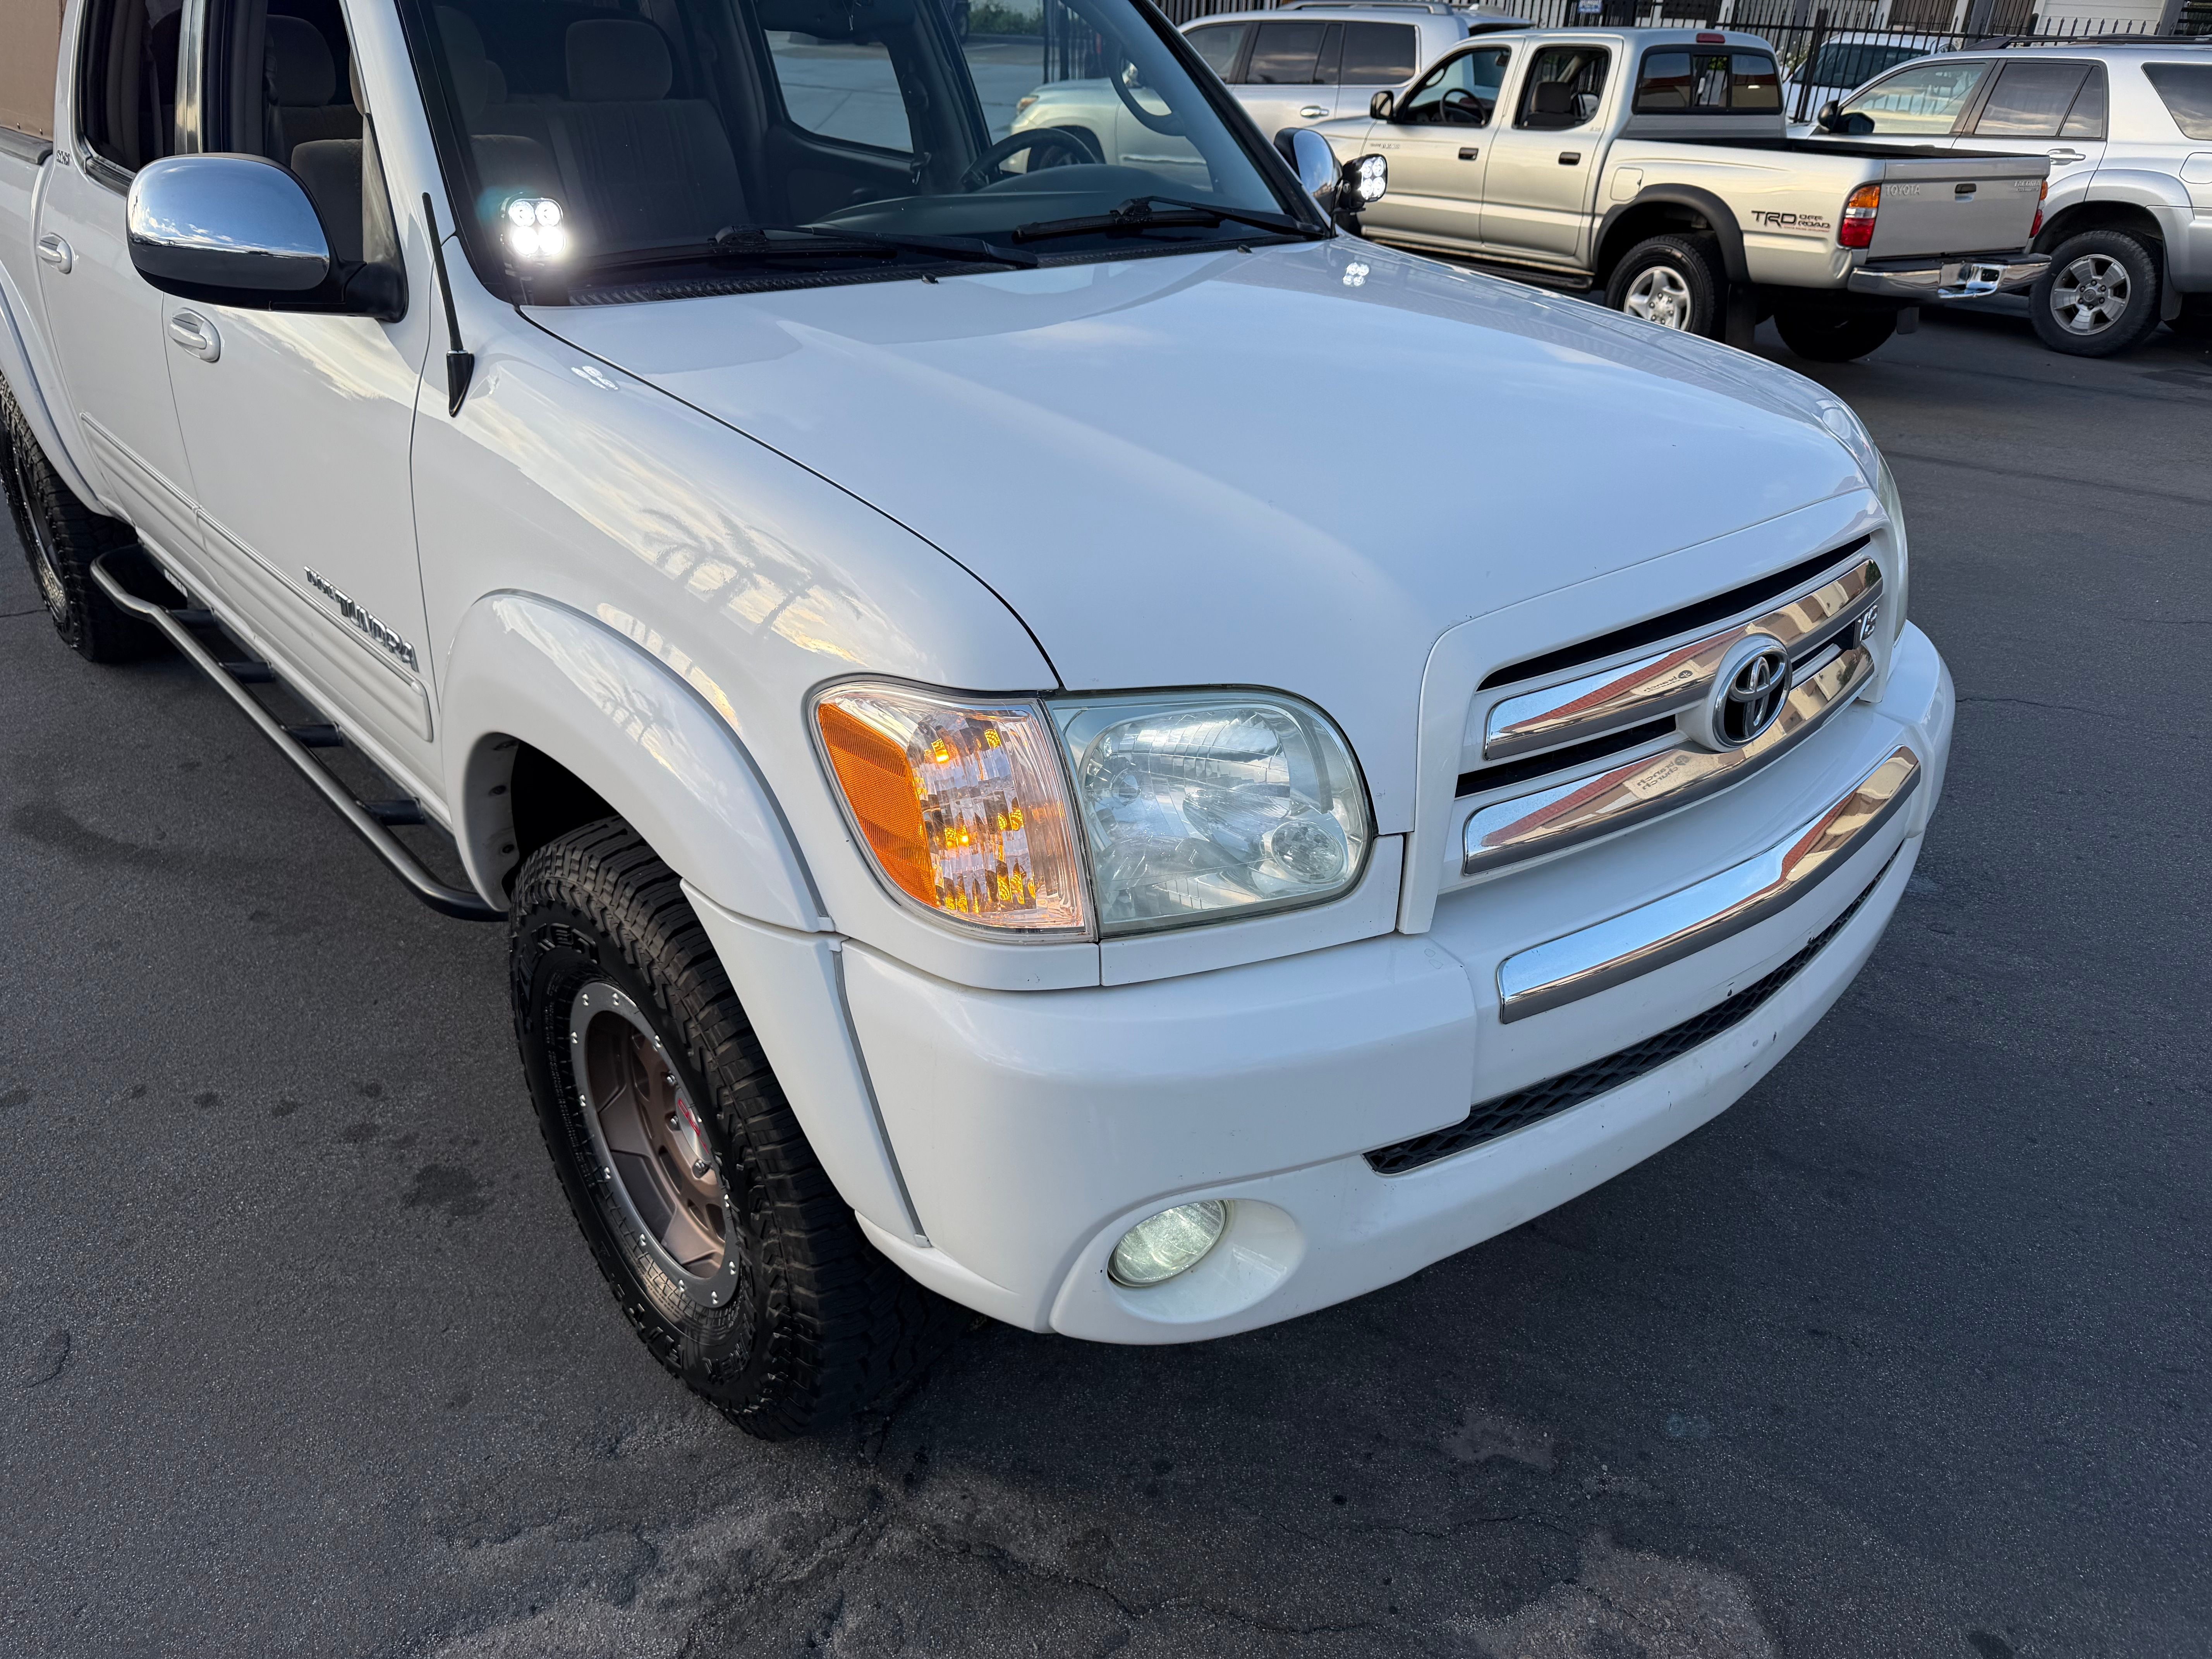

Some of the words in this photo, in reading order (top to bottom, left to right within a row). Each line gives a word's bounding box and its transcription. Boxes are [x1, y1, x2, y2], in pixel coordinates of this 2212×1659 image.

[1886, 184, 1920, 196] TOYOTA
[1751, 210, 1797, 228] TRD
[1798, 220, 1831, 229] ROAD
[335, 589, 419, 673] TUNDRA
[1858, 604, 1878, 641] V8
